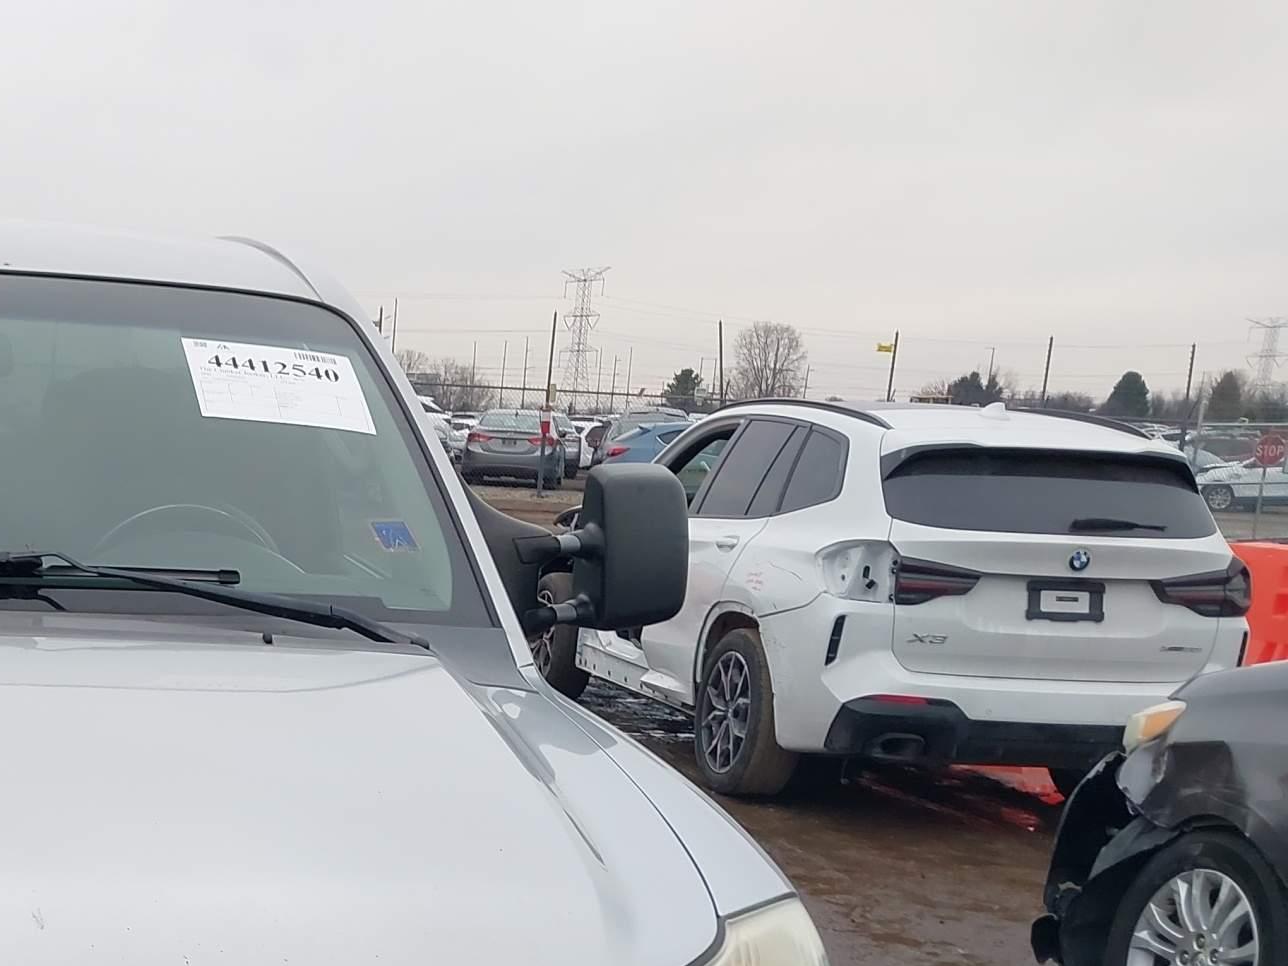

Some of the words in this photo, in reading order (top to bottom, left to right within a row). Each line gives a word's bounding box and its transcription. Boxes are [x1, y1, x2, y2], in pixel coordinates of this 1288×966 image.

[208, 354, 339, 382] 44412540
[1256, 444, 1283, 457] STOP
[907, 633, 948, 644] X3
